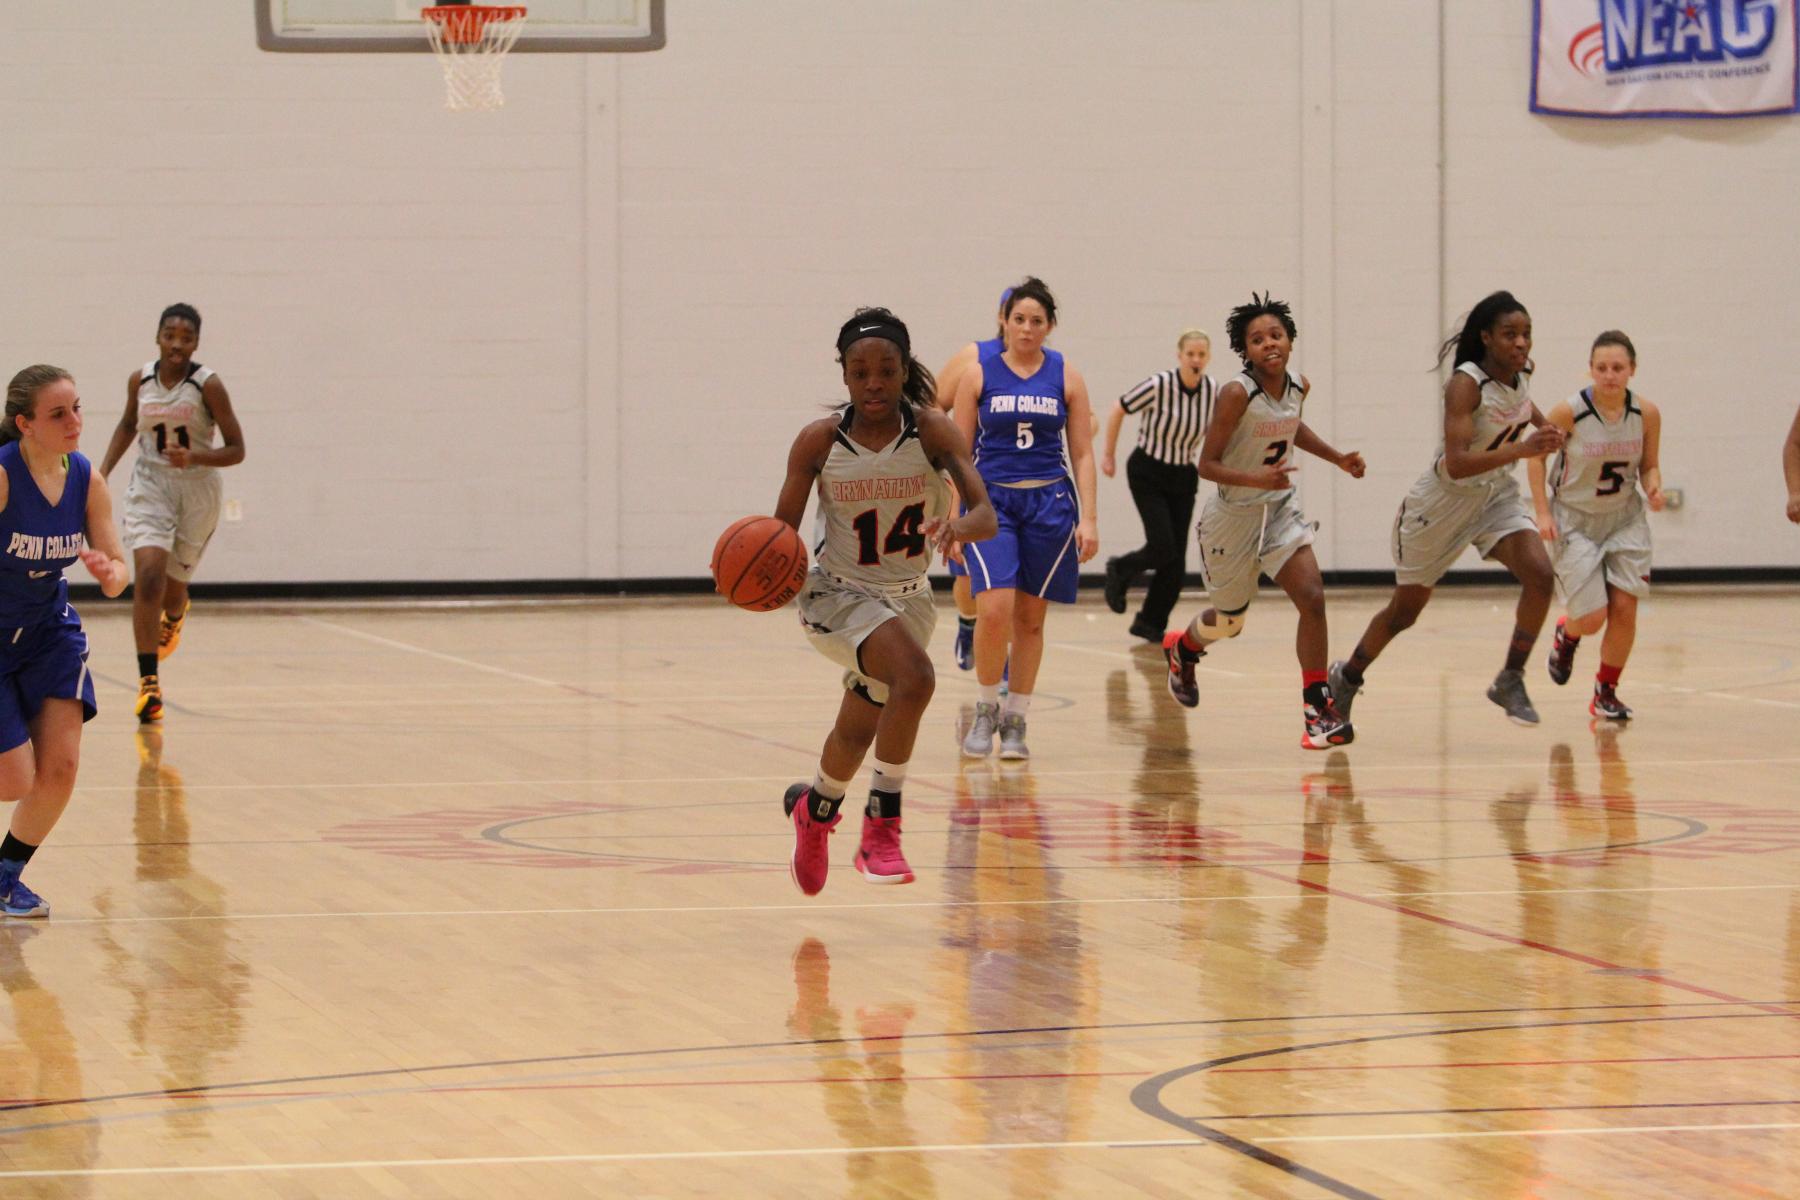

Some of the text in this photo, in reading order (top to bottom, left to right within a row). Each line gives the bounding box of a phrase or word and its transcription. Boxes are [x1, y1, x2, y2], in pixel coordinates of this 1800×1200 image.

[1602, 0, 1775, 71] NEAC
[990, 395, 1059, 416] PENN COLLEGE
[151, 422, 190, 455] 11
[1016, 422, 1034, 449] 5
[1596, 461, 1630, 497] 5
[6, 532, 82, 560] PENN COLLEG
[853, 500, 926, 566] 14
